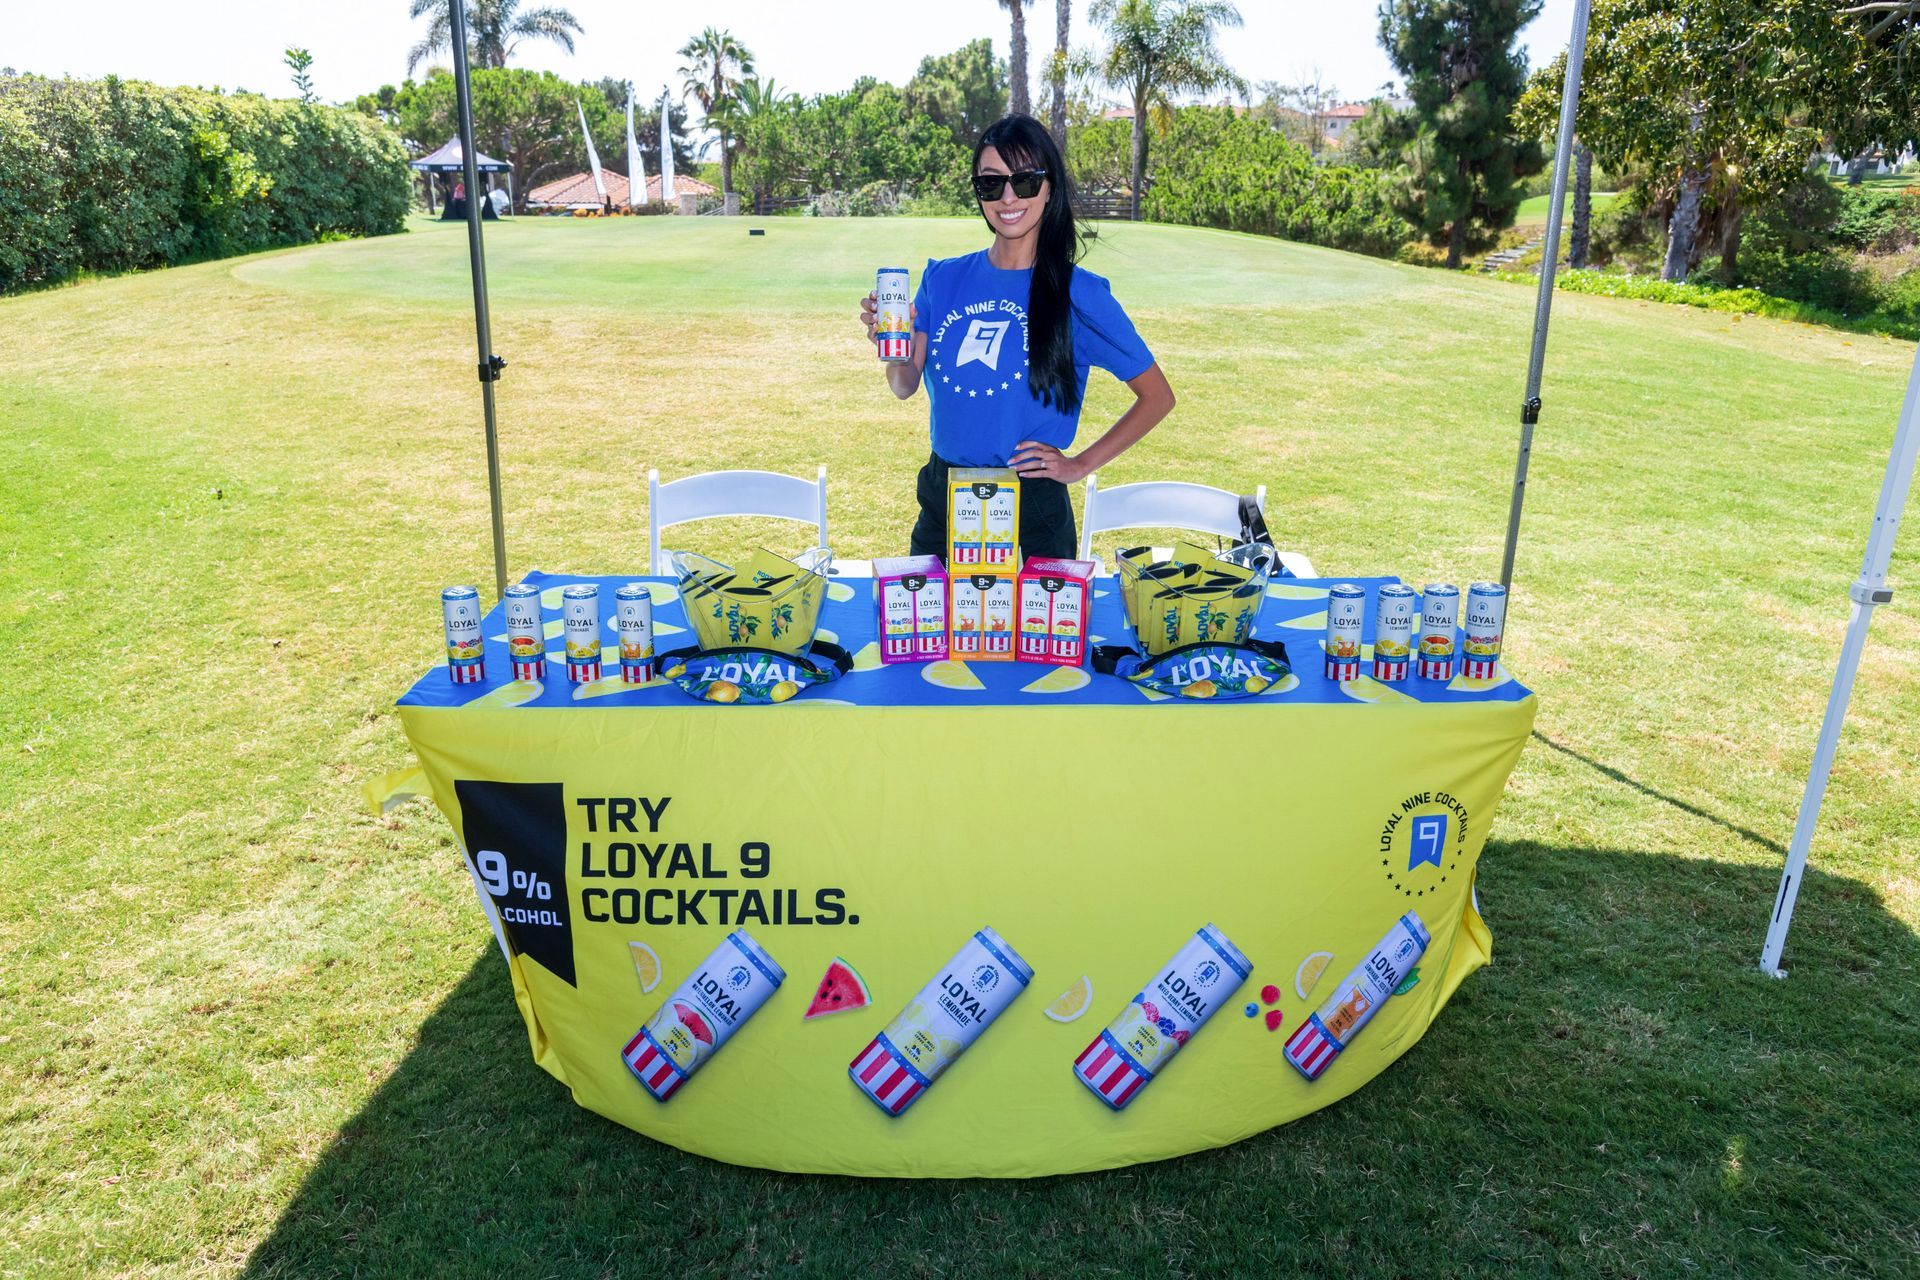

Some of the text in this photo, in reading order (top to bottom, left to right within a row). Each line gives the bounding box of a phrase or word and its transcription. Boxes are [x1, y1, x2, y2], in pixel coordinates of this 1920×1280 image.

[932, 309, 963, 343] LOYAL
[964, 300, 996, 316] NINE
[1025, 600, 1047, 608] LOYAL
[1197, 602, 1210, 639] LOYAL
[1424, 614, 1452, 624] LOYAL
[1467, 614, 1496, 624] LOYAL
[449, 618, 477, 628] LOYAL
[507, 617, 534, 625] LOYAL
[566, 619, 593, 627] LOYAL
[618, 620, 644, 628] LOYAL
[1334, 617, 1360, 626] LOYAL
[1385, 617, 1412, 625] LOYAL
[700, 663, 806, 689] LOYAL
[1171, 654, 1272, 686] LOYAL
[577, 797, 672, 832] TRY
[1380, 792, 1468, 852] LOYAL NINE COCKTAILS
[1419, 821, 1440, 857] 9
[477, 850, 552, 900] 9%
[581, 841, 771, 878] LOYAL 9
[497, 905, 563, 926] LCOHOL
[581, 887, 860, 925] COCKTAILS.
[1370, 951, 1399, 988] LOYAL
[696, 971, 742, 1022] LOYAL
[936, 993, 971, 1026] LEMONADE
[940, 974, 987, 1023] LOYAL
[1163, 970, 1208, 1017] LOYAL
